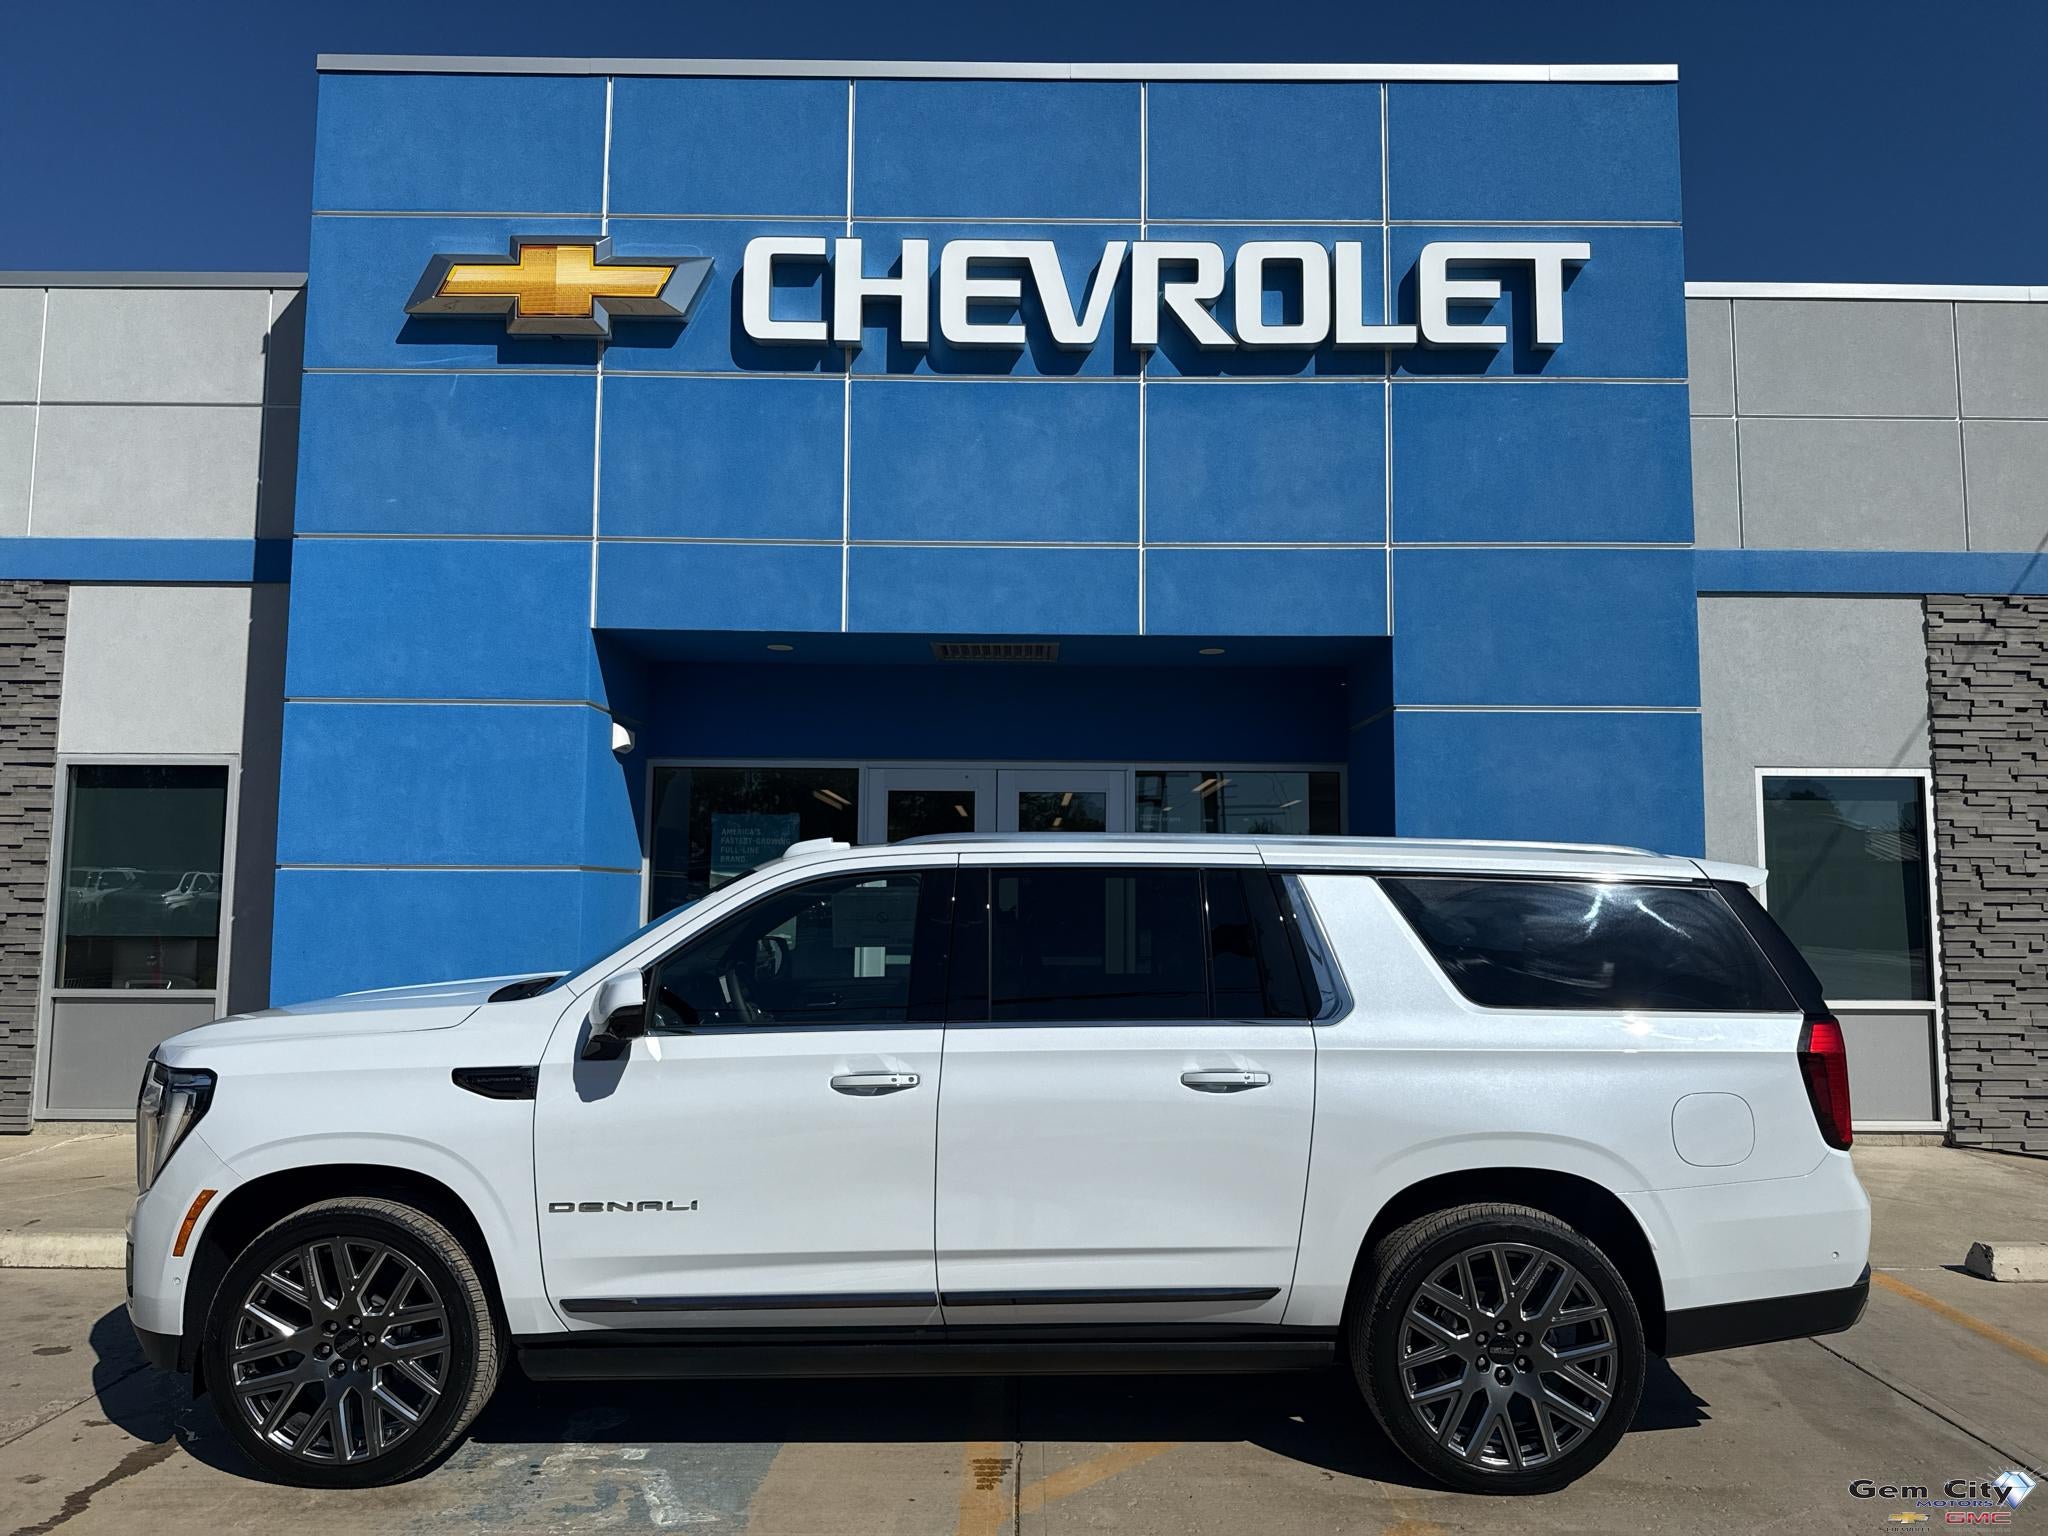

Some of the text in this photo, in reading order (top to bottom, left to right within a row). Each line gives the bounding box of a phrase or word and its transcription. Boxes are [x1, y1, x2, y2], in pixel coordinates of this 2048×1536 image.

[742, 236, 1592, 348] CHEVROLET
[721, 828, 761, 836] AMERICA'S
[720, 837, 791, 845] FASTEST-GROWING
[720, 846, 760, 854] FULL-LINE
[548, 1200, 698, 1213] DENALI
